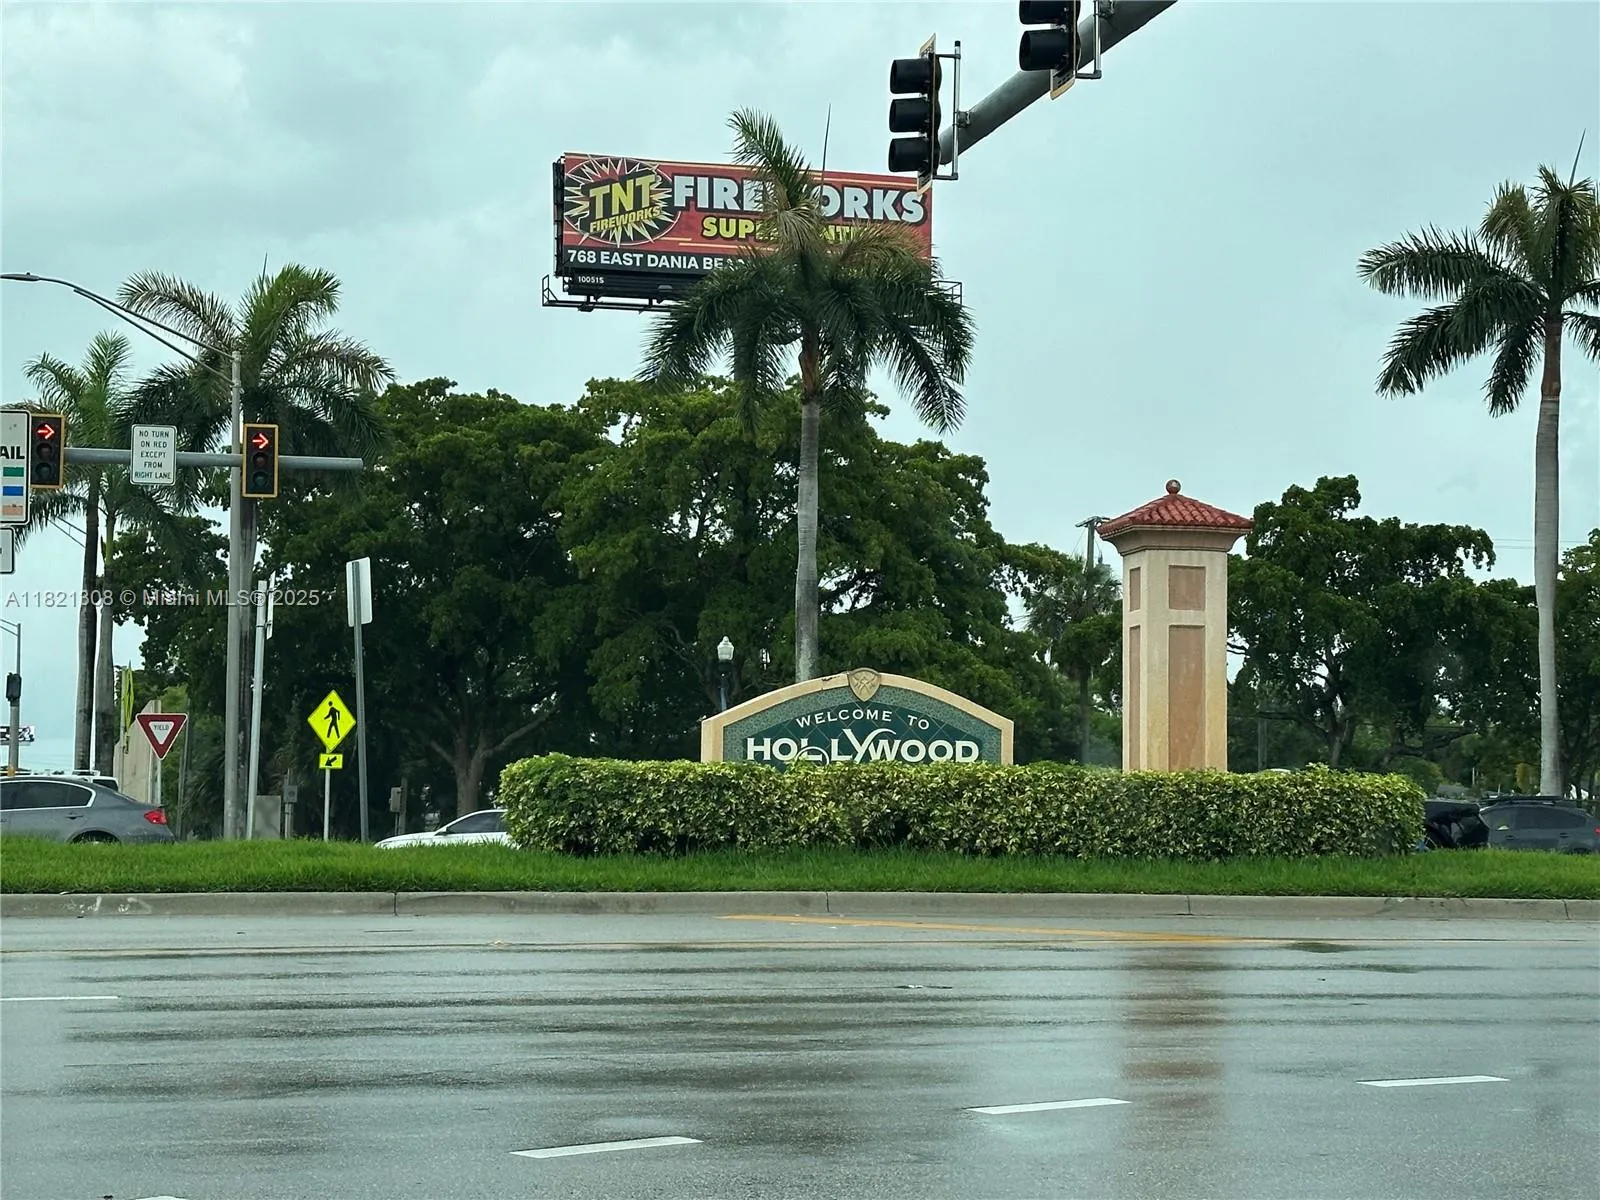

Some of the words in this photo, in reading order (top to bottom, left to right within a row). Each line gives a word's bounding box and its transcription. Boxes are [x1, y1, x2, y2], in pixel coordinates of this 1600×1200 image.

[590, 174, 656, 219] TNT
[674, 175, 924, 223] FIREORKS
[590, 205, 661, 233] FIREWORKS
[568, 249, 597, 264] 768
[600, 251, 644, 267] EAST
[647, 255, 700, 270] DANIA
[140, 440, 150, 448] ON
[135, 471, 152, 479] RIGHT
[155, 472, 171, 480] LANE
[796, 708, 893, 729] WELCOME
[907, 714, 930, 731] TO
[746, 728, 980, 764] HOLLYWOOD
